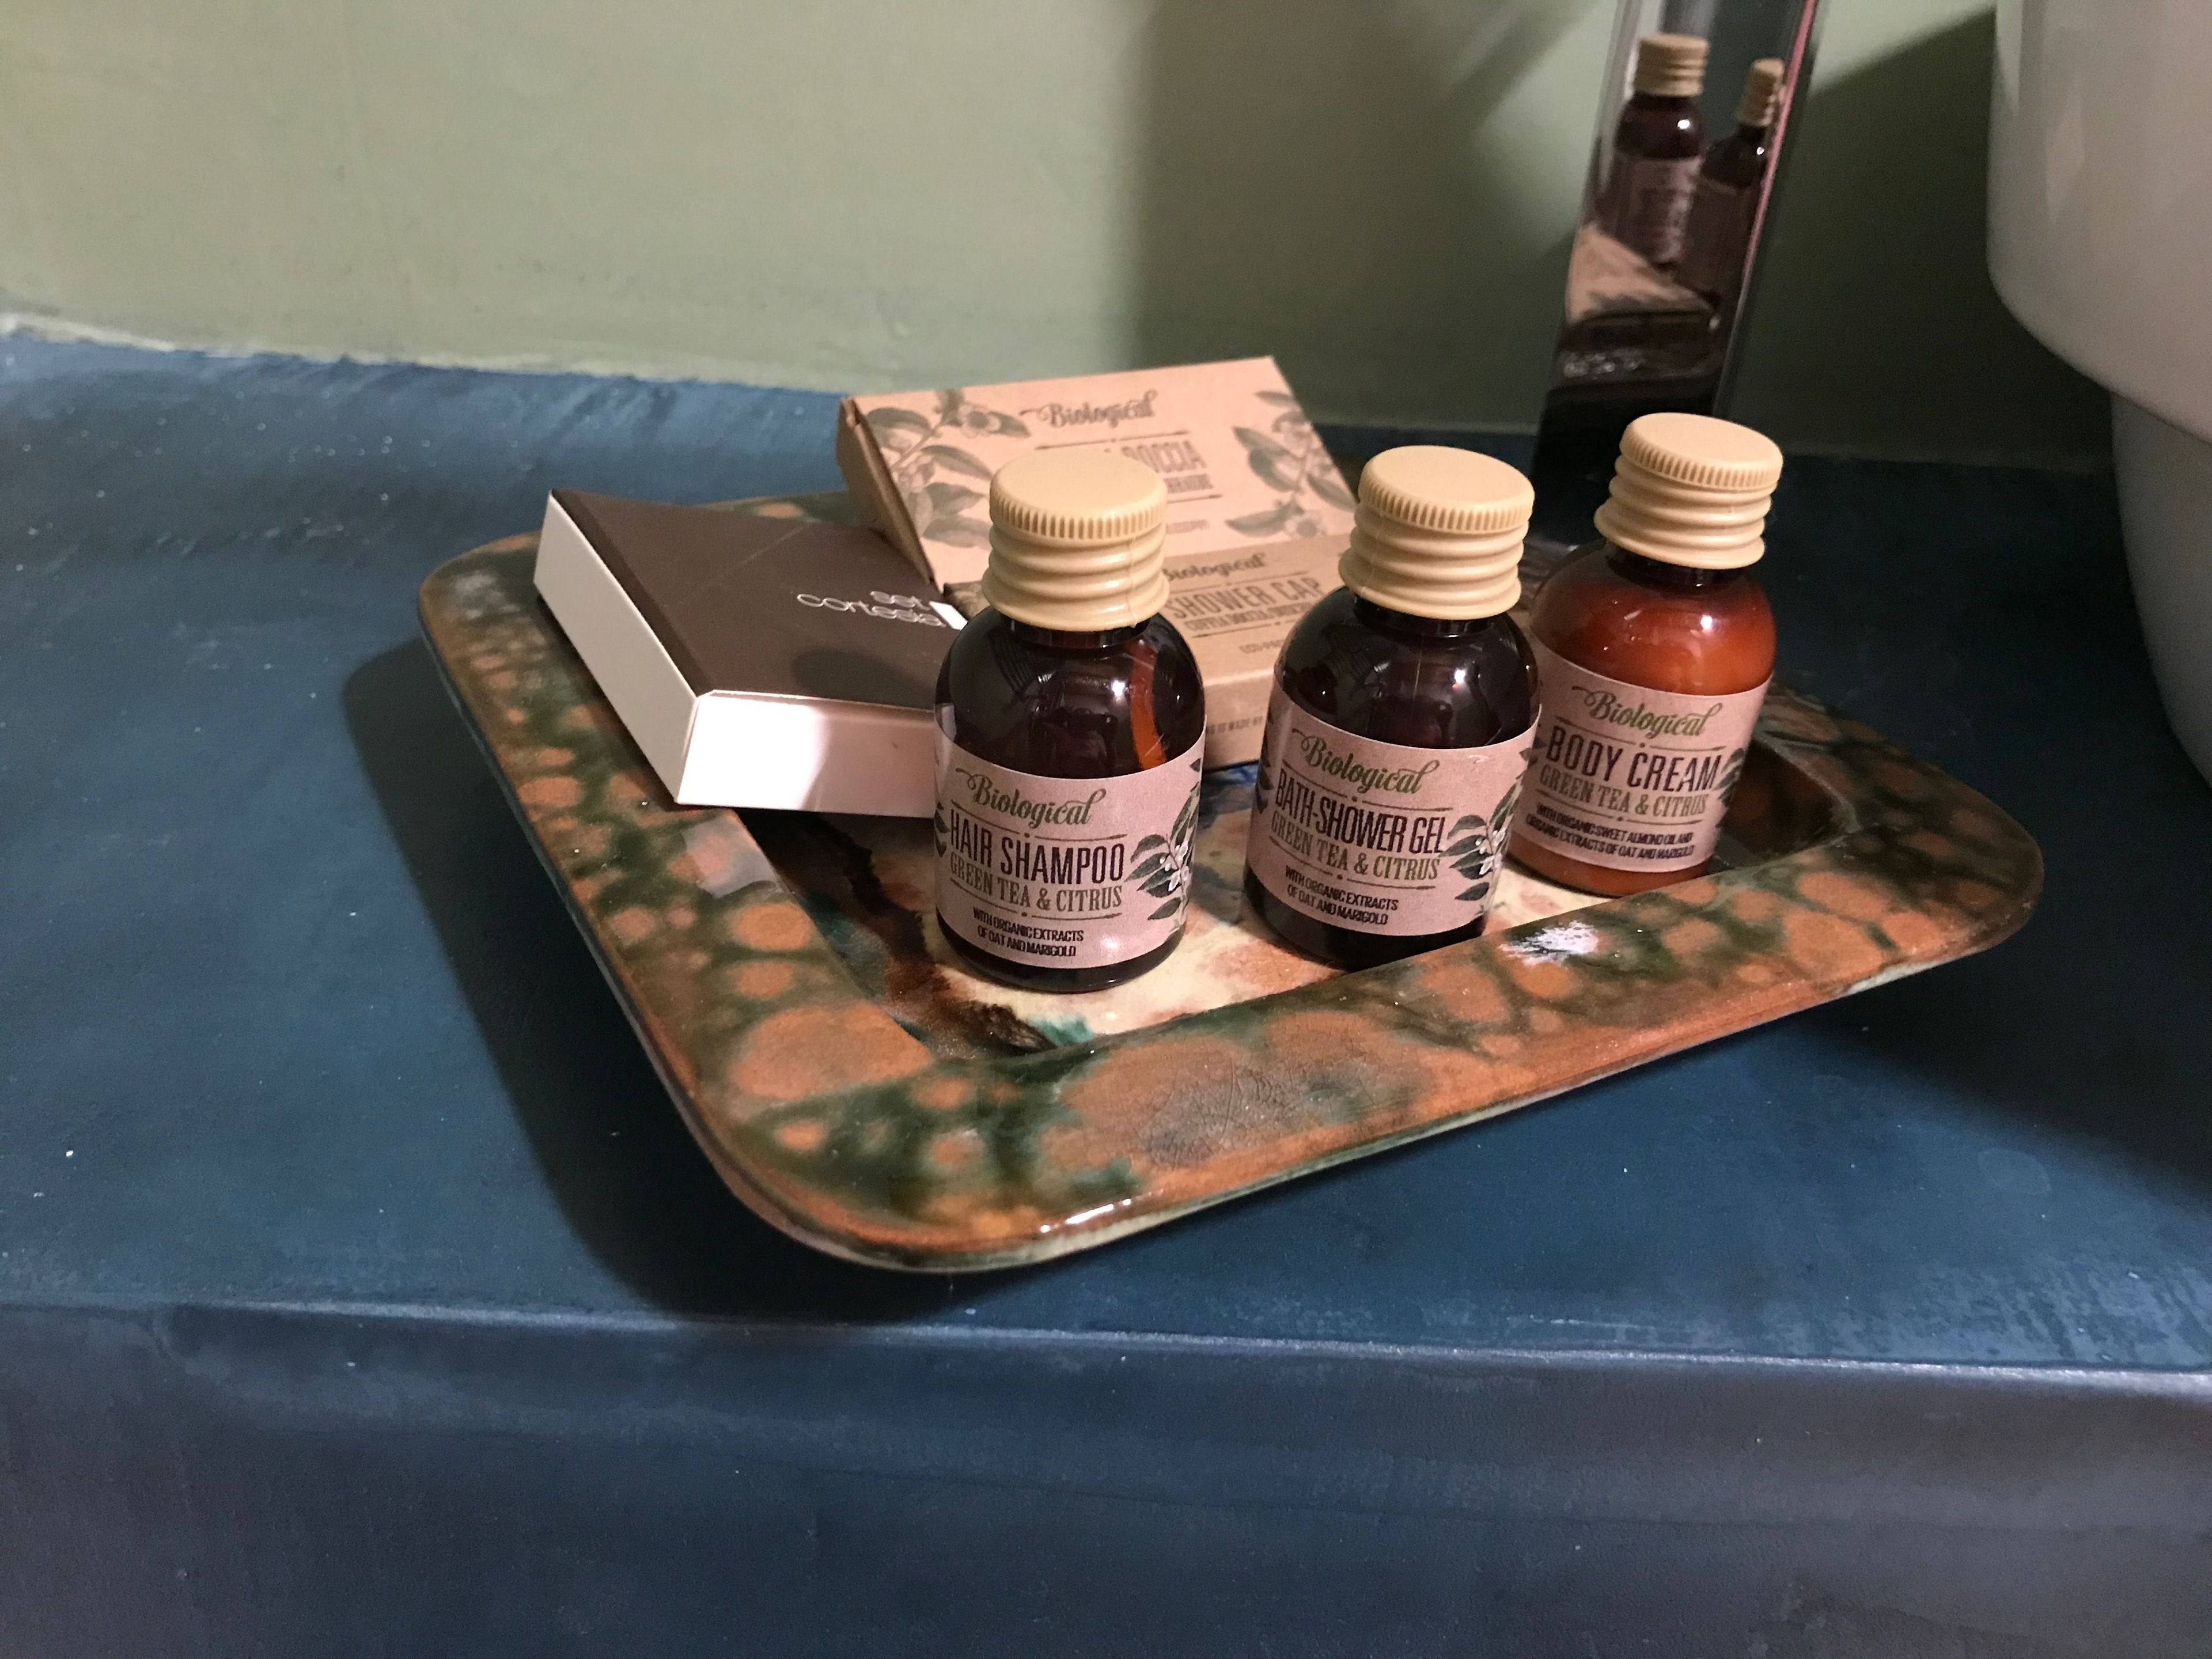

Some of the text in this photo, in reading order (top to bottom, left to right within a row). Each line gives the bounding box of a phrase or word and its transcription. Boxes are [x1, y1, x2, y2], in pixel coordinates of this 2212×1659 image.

[1018, 389, 1157, 429] Biological
[1164, 585, 1277, 619] SHOWER
[1270, 577, 1324, 600] CAP
[1571, 685, 1723, 740] Biological
[1291, 728, 1440, 794] Biological
[1546, 725, 1722, 792] BODY CREAM
[956, 767, 1107, 829] Biological
[1275, 768, 1445, 855] BATH-SHOWER GEL
[1540, 764, 1709, 817] GREEN TEA & CITRUS
[950, 808, 1124, 885] HAIR SHAMPOO
[1271, 810, 1440, 880] GREEN TEA & CITRUS
[1556, 812, 1596, 835] ORGANIC
[1596, 825, 1628, 842] SWEET
[1626, 831, 1664, 845] ALMOND
[1560, 830, 1606, 853] EXTRACTS
[1605, 843, 1620, 854] OF
[1619, 845, 1638, 857] OAT
[1638, 848, 1657, 859] AND
[950, 851, 1123, 912] GREEN TEA & CITRUS
[1286, 865, 1399, 911] WITH ORGANIC EXTRACTS
[1287, 884, 1389, 925] OF OAT AND MARIGOLD
[973, 907, 1084, 942] WITH ORGANIC EXTRACTS
[978, 925, 1076, 957] OF OAT AND MARIGOLD
